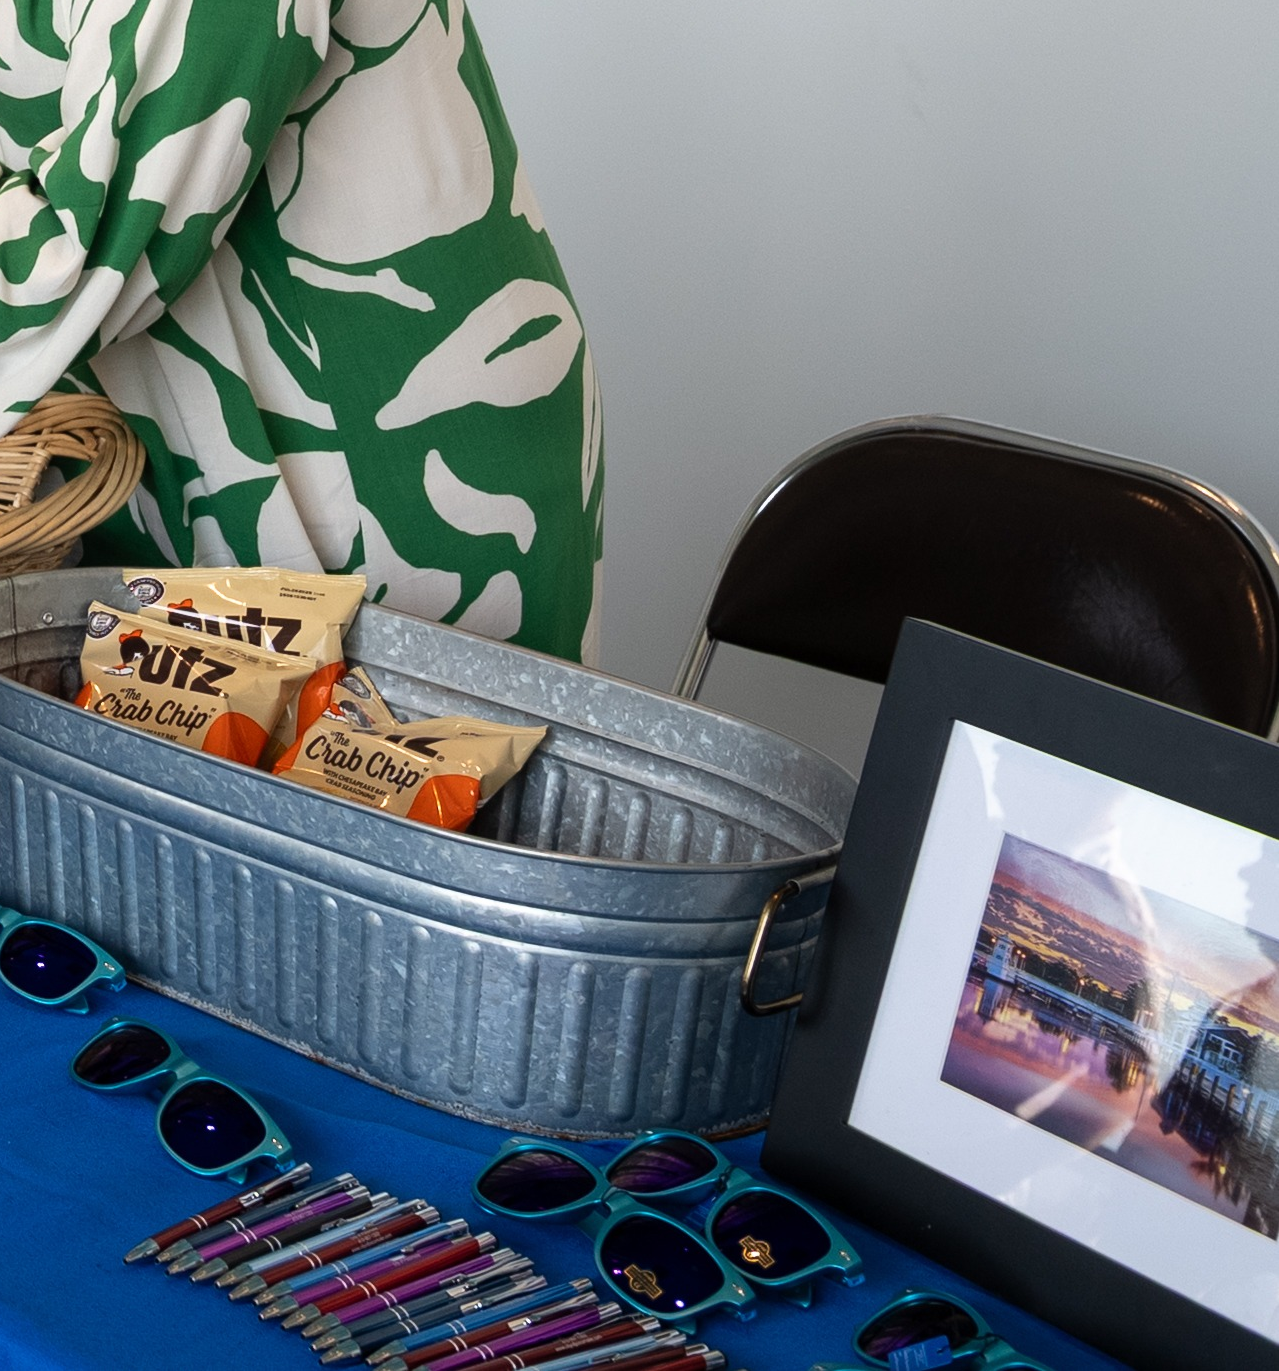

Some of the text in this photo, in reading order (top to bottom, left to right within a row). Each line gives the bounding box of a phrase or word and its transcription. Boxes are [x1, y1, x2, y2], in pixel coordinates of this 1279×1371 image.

[93, 692, 154, 723] Crab
[305, 734, 363, 772] Crab
[323, 767, 388, 797] WITH CHESAPEAKE BAY
[325, 777, 377, 801] CRAB SEASONING
